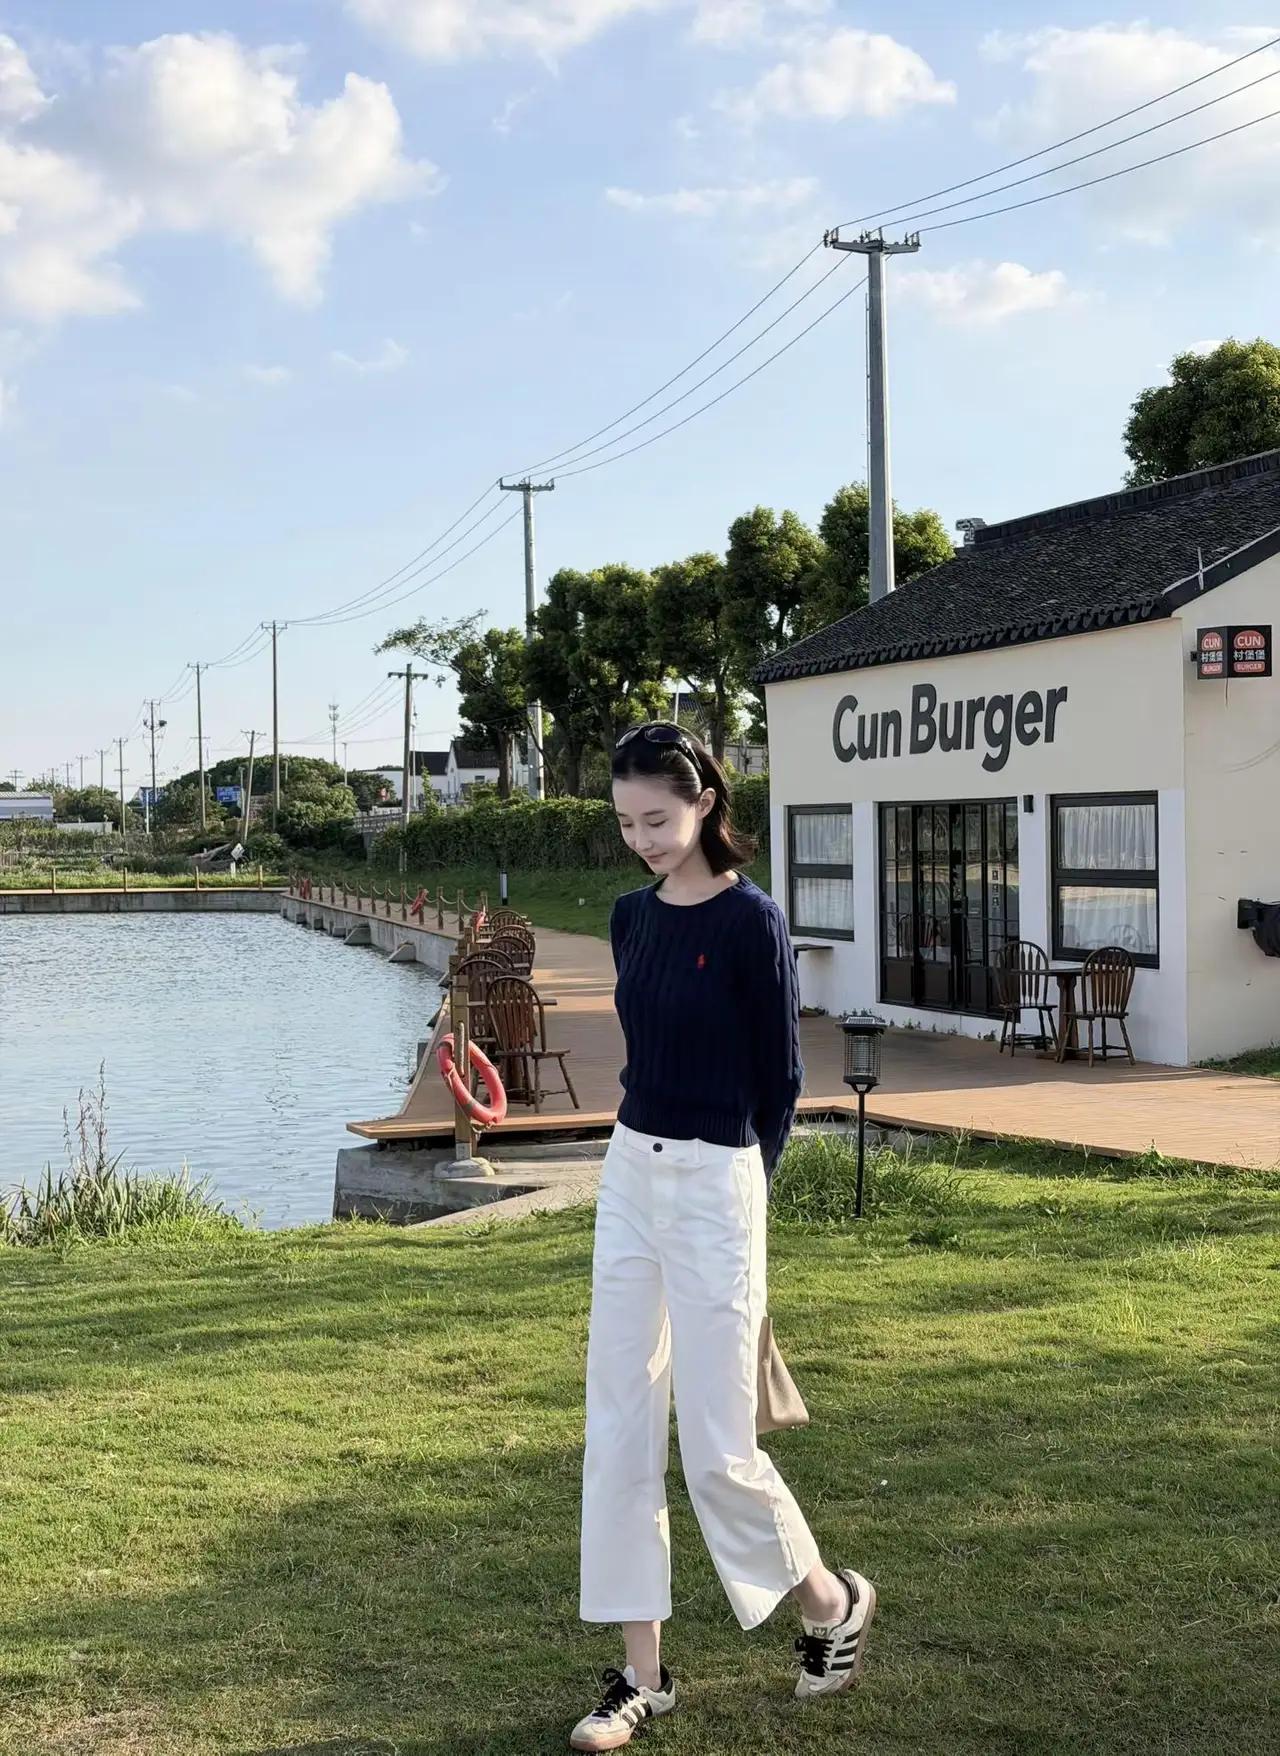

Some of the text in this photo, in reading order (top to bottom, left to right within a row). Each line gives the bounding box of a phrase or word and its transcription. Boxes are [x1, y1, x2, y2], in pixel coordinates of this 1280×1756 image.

[1204, 638, 1220, 648] CUN
[1237, 636, 1261, 646] CUN
[832, 683, 1068, 773] Cun Burger
